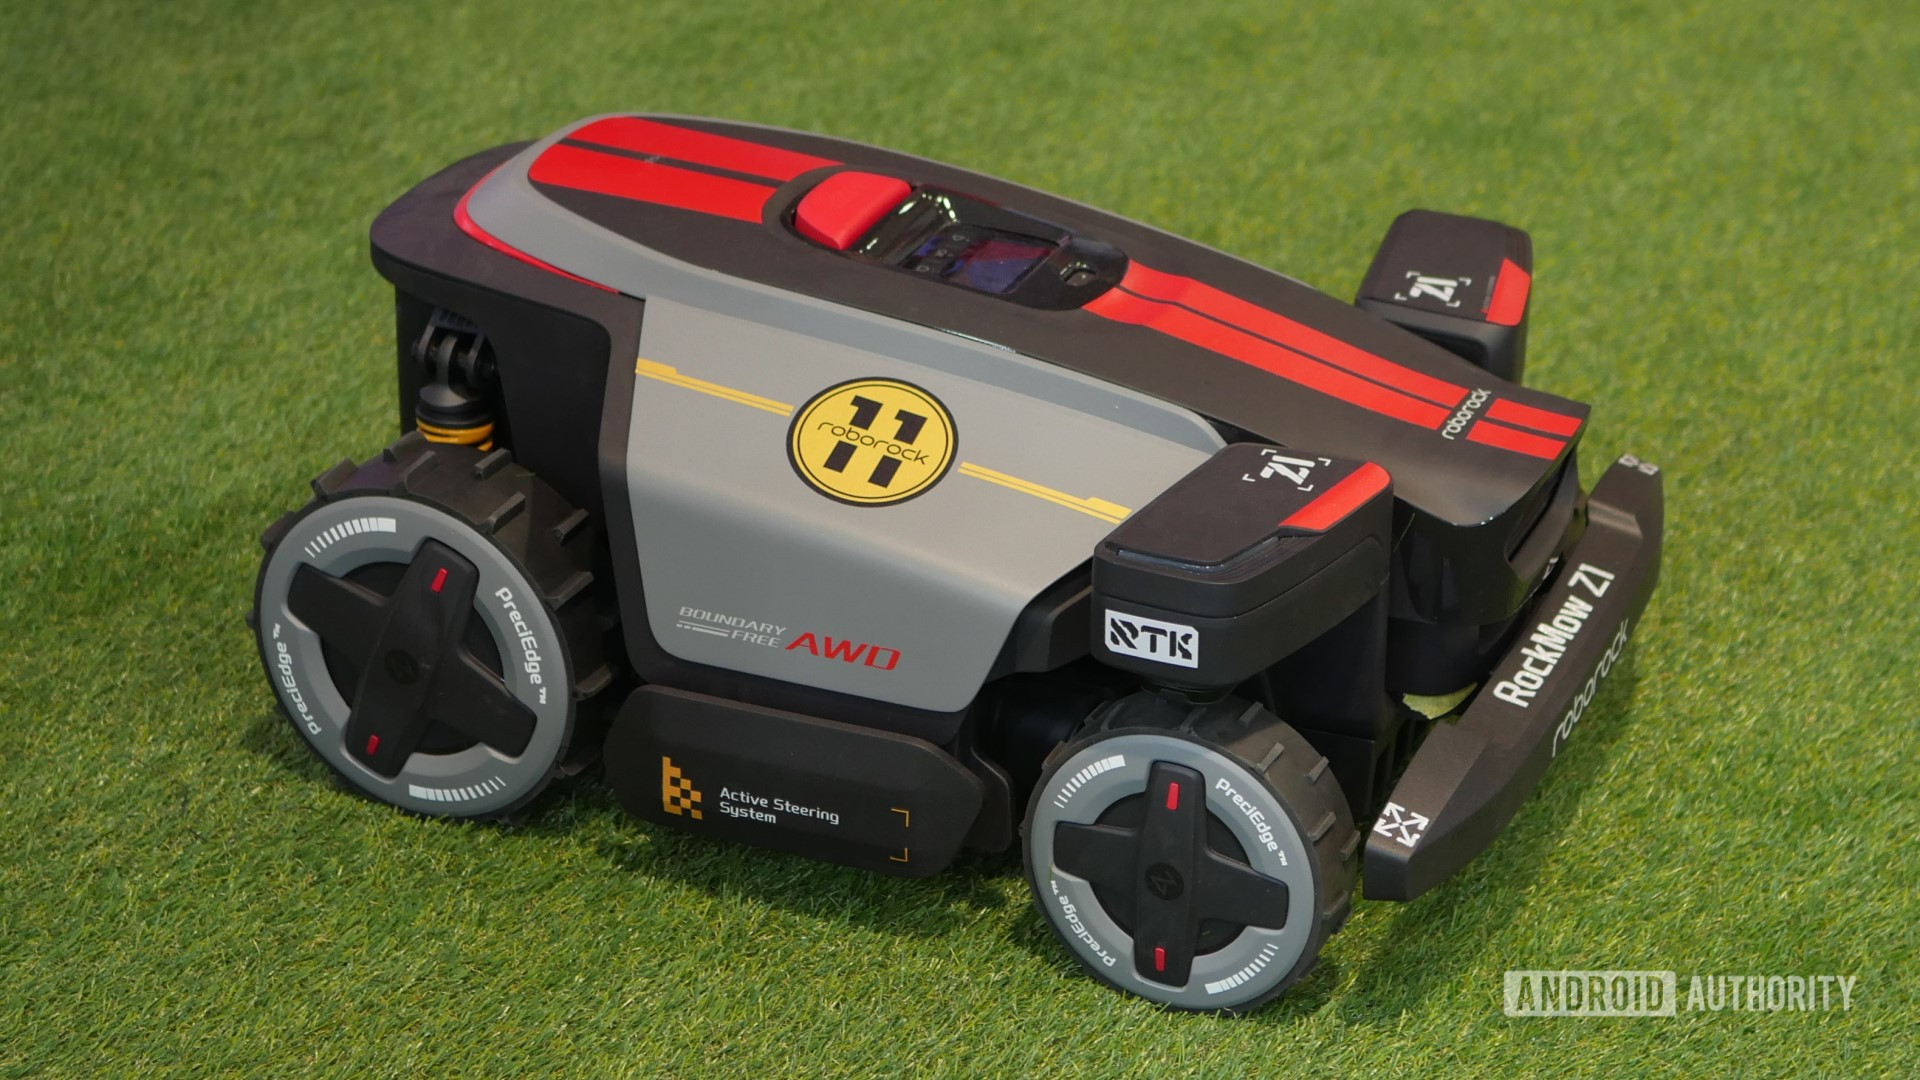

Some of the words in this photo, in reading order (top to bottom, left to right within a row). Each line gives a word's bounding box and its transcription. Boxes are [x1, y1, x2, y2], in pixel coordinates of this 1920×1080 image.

[1443, 388, 1492, 440] roborock
[817, 422, 930, 465] roborock
[496, 587, 543, 685] PreciEdge
[680, 606, 787, 635] BOUNDARY
[731, 629, 781, 648] FREE
[1110, 617, 1193, 661] RTK
[785, 632, 901, 671] AWD
[1493, 595, 1594, 708] RockMow
[276, 642, 322, 736] PreciEdge
[1552, 618, 1629, 758] roborock
[719, 787, 769, 808] Active
[773, 798, 840, 826] Steering
[719, 802, 776, 824] System
[1216, 778, 1278, 853] PreciEdge
[1059, 894, 1116, 968] PreciEdge
